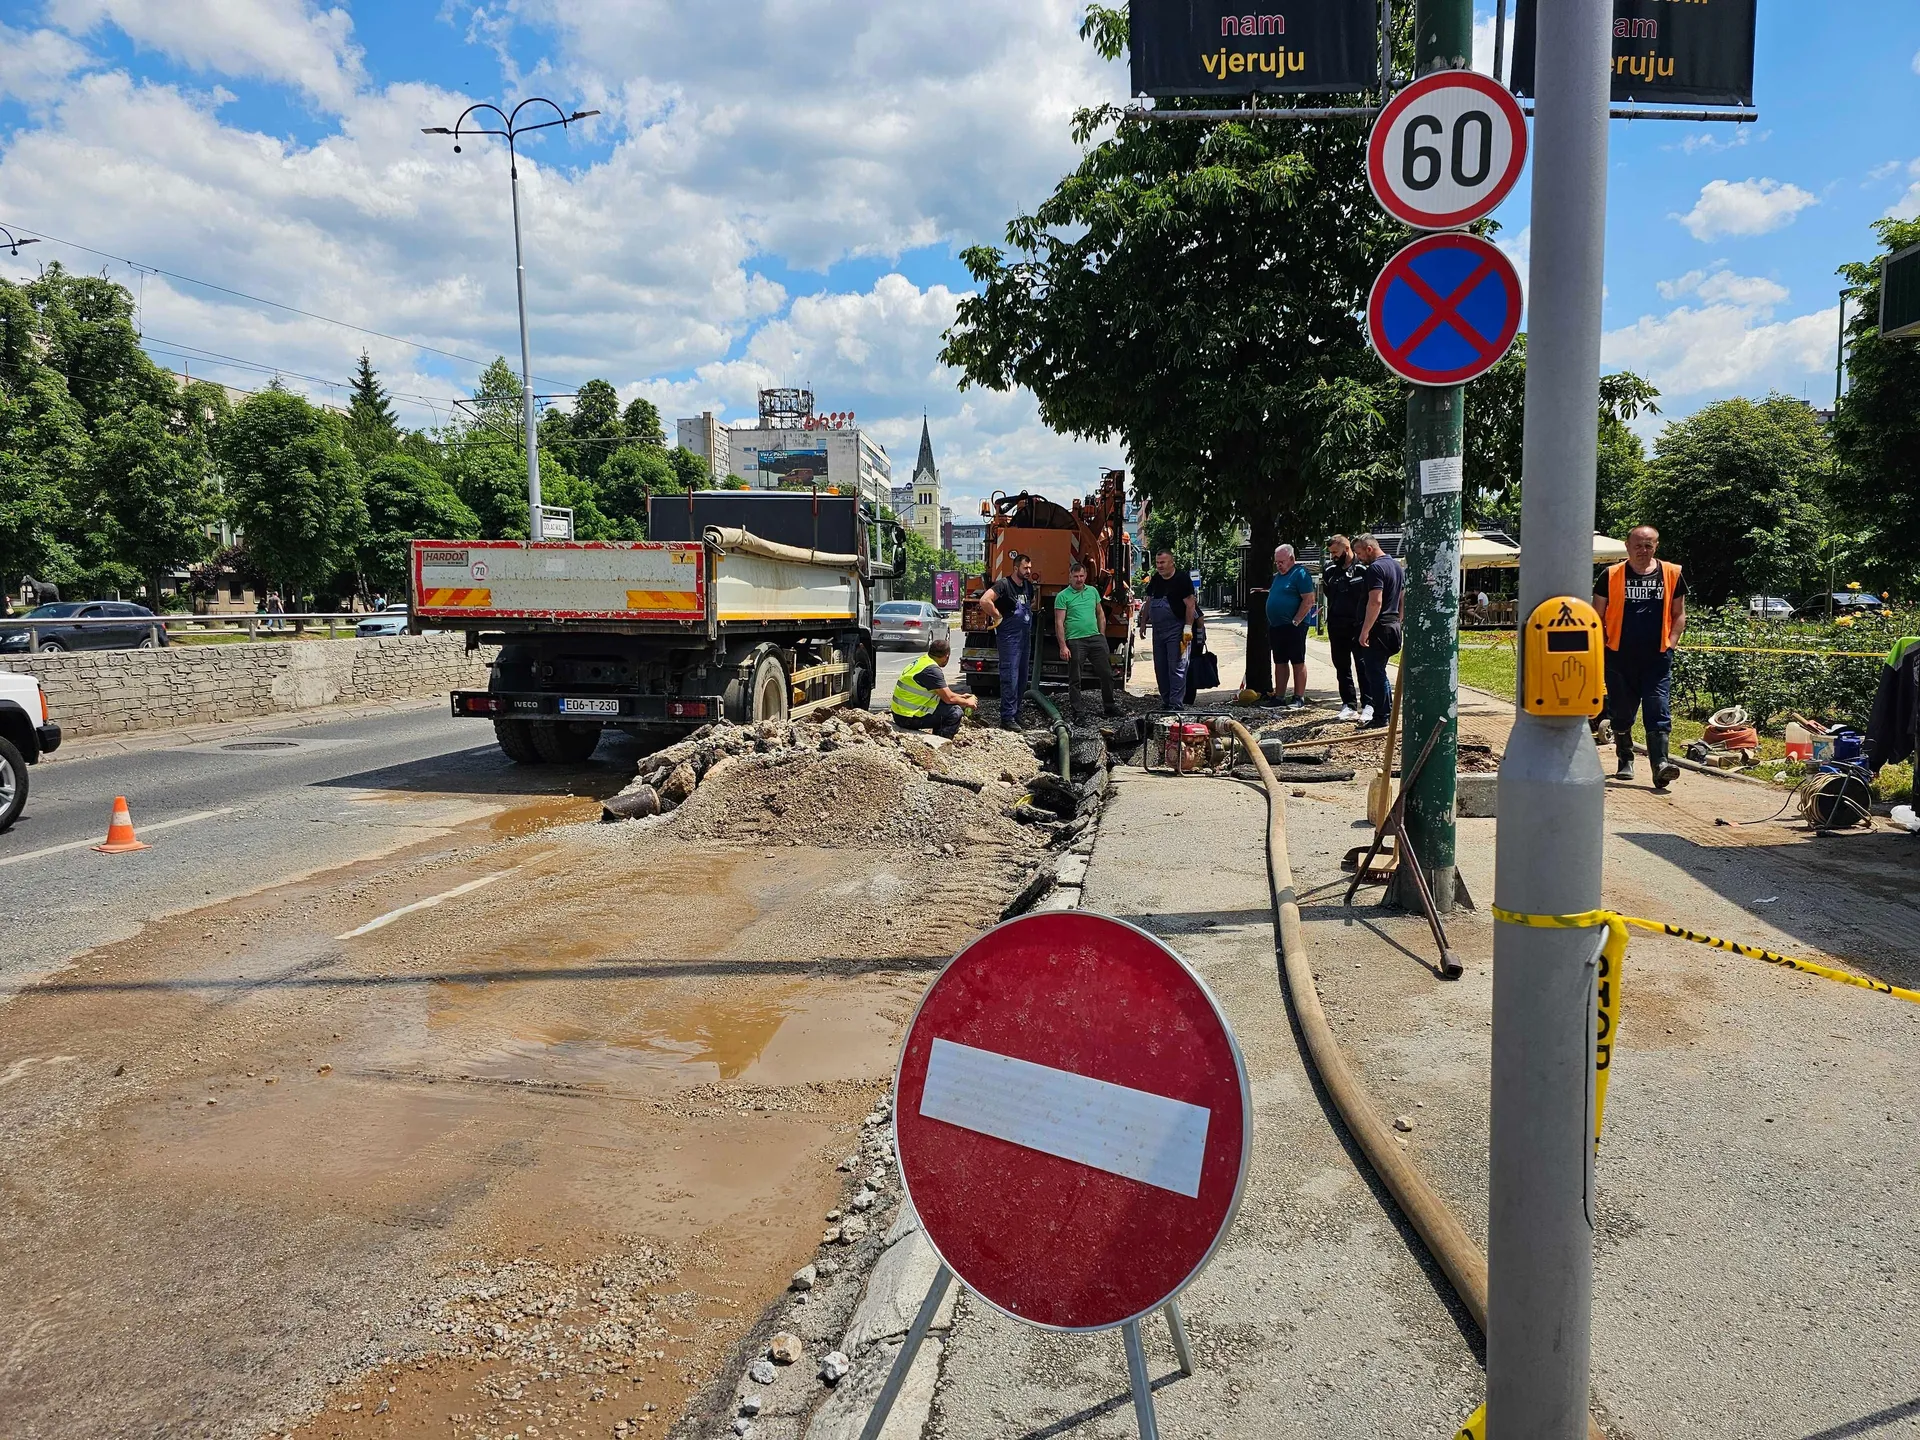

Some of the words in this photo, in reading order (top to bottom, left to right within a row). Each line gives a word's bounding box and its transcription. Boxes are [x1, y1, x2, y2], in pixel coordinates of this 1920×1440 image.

[1221, 14, 1285, 36] nam
[1613, 17, 1658, 38] am
[1201, 46, 1304, 80] vjeruju
[1611, 51, 1675, 82] ruju
[1403, 110, 1492, 191] 60
[426, 553, 464, 561] HARDOX
[475, 567, 485, 576] 70
[566, 700, 618, 711] E06-T-230
